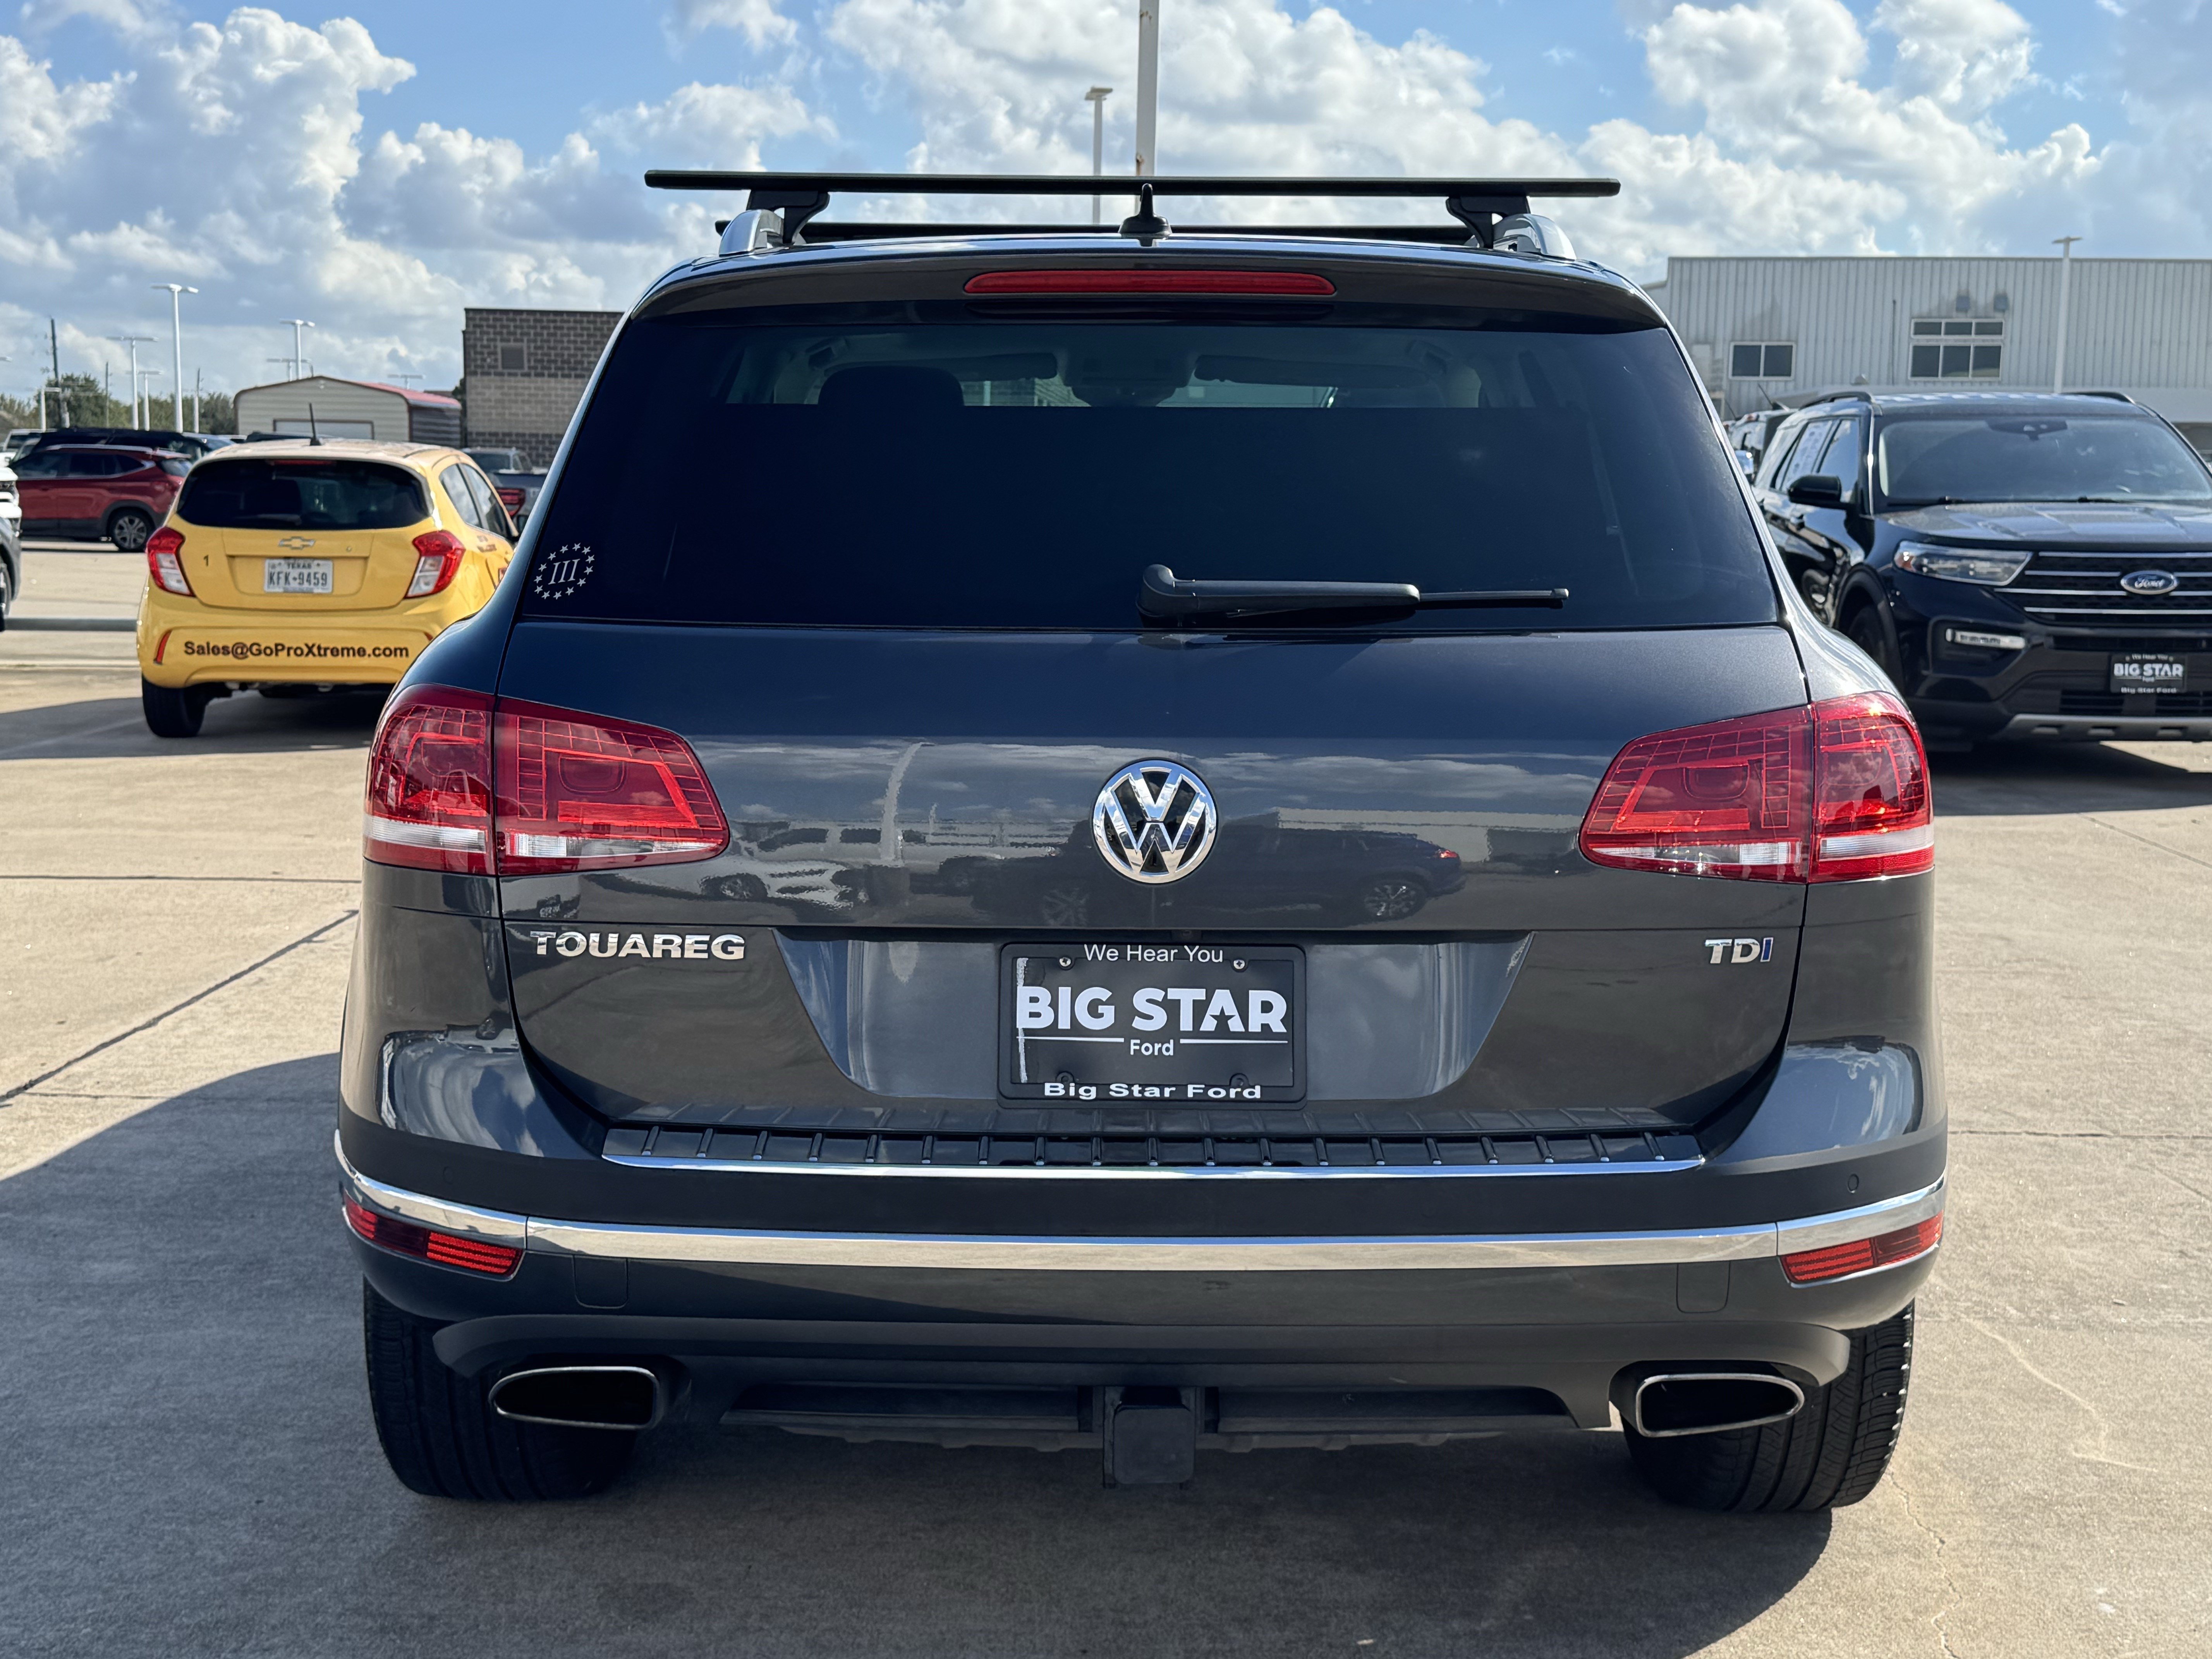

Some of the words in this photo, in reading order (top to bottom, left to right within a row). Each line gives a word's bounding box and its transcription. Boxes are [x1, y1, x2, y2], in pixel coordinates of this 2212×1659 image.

[203, 555, 208, 567] 1
[548, 559, 580, 585] III
[184, 641, 409, 659] Sales@GoProXtreme.com
[2114, 663, 2140, 676] BIG
[2143, 663, 2183, 677] STAR
[530, 931, 745, 960] TOUAREG
[1084, 945, 1118, 961] We
[1127, 945, 1177, 962] Hear
[1184, 946, 1223, 962] You
[1705, 937, 1774, 963] TDI
[1017, 986, 1115, 1030] BIG
[1132, 988, 1287, 1032] STAR
[1130, 1039, 1174, 1056] Ford
[1044, 1083, 1096, 1099] Big
[1109, 1084, 1176, 1097] Star
[1187, 1085, 1261, 1098] Ford
